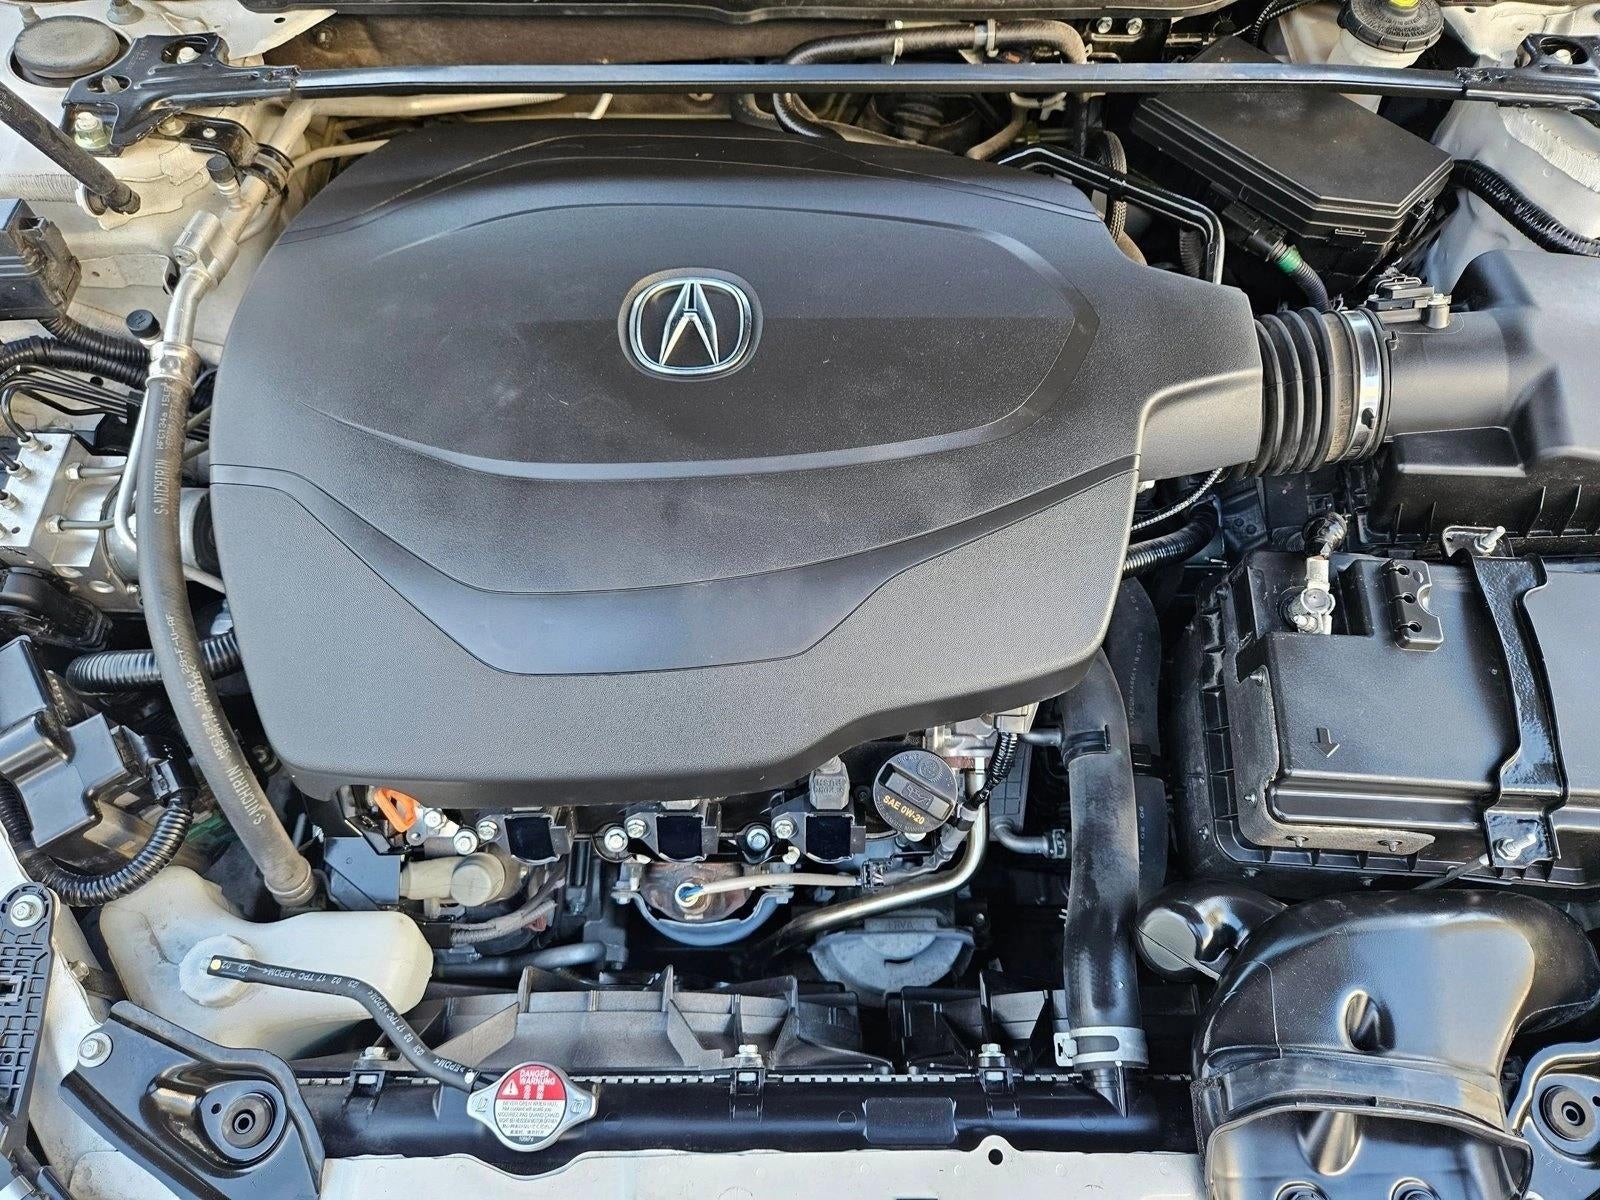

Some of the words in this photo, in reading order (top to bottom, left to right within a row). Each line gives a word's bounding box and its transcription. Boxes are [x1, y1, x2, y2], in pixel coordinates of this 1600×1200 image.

[883, 795, 900, 810] SAE
[900, 806, 925, 825] 0W-20
[298, 971, 315, 981] TPC
[519, 1069, 550, 1078] DANGER
